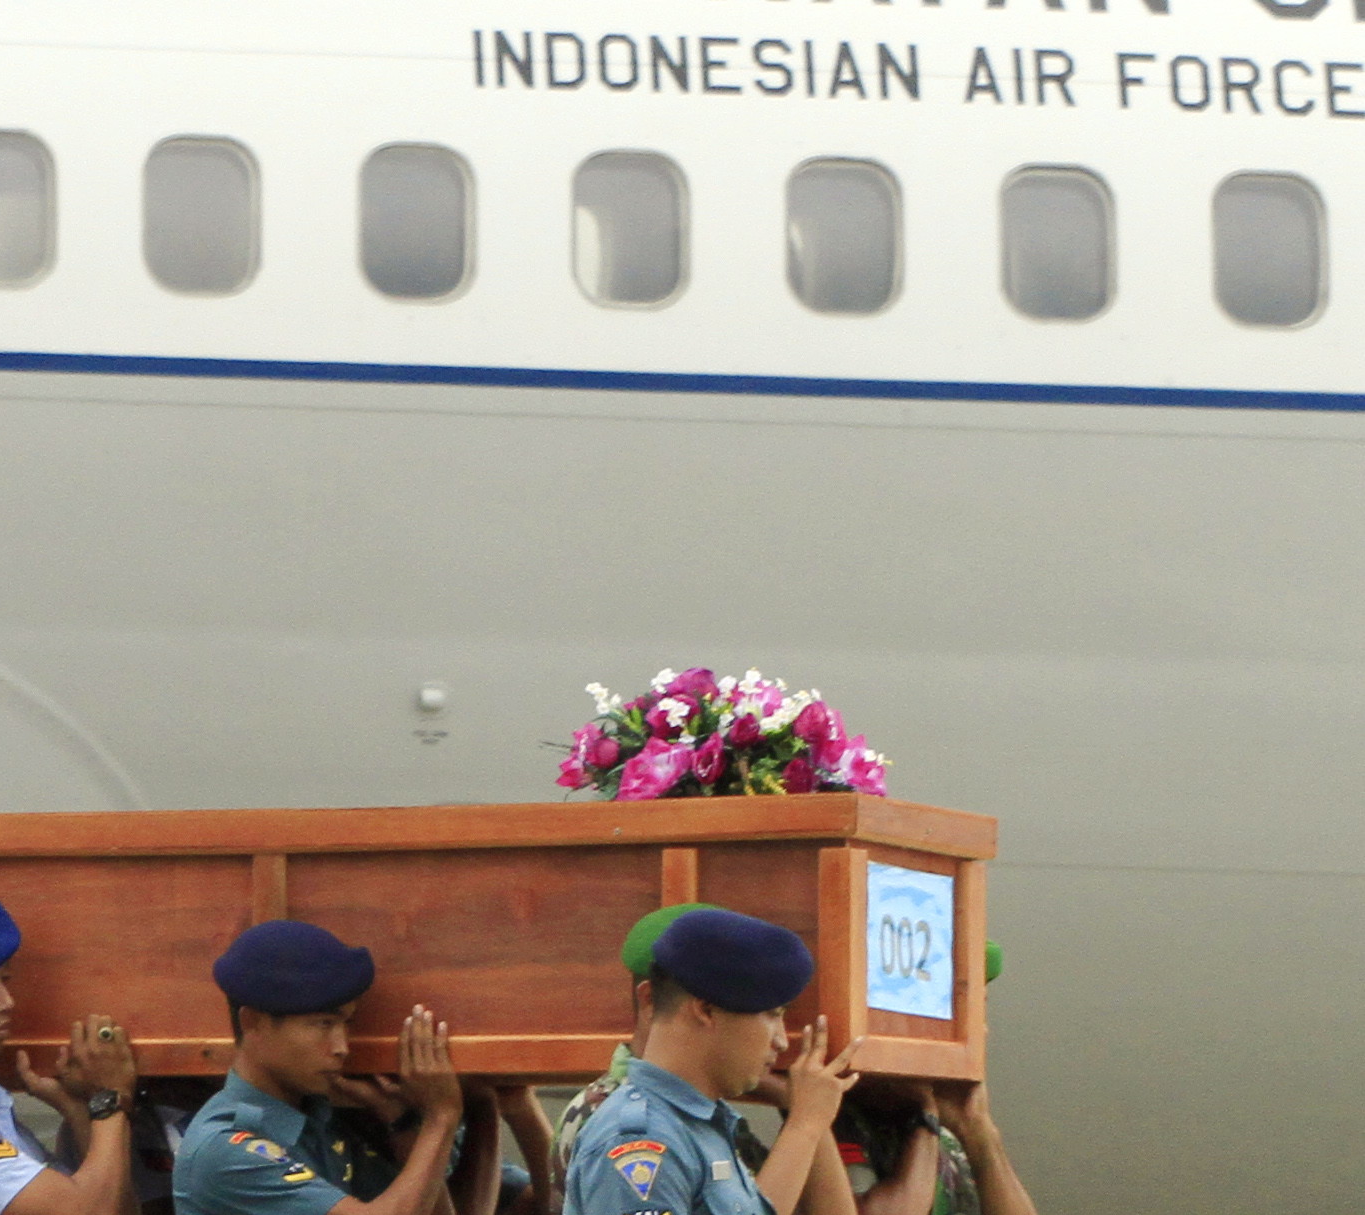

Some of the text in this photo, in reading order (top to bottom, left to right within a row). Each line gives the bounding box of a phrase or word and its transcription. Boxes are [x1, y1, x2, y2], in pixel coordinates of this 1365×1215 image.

[472, 29, 1365, 119] INDONESIAN AIR FORCE
[880, 914, 932, 981] 002
